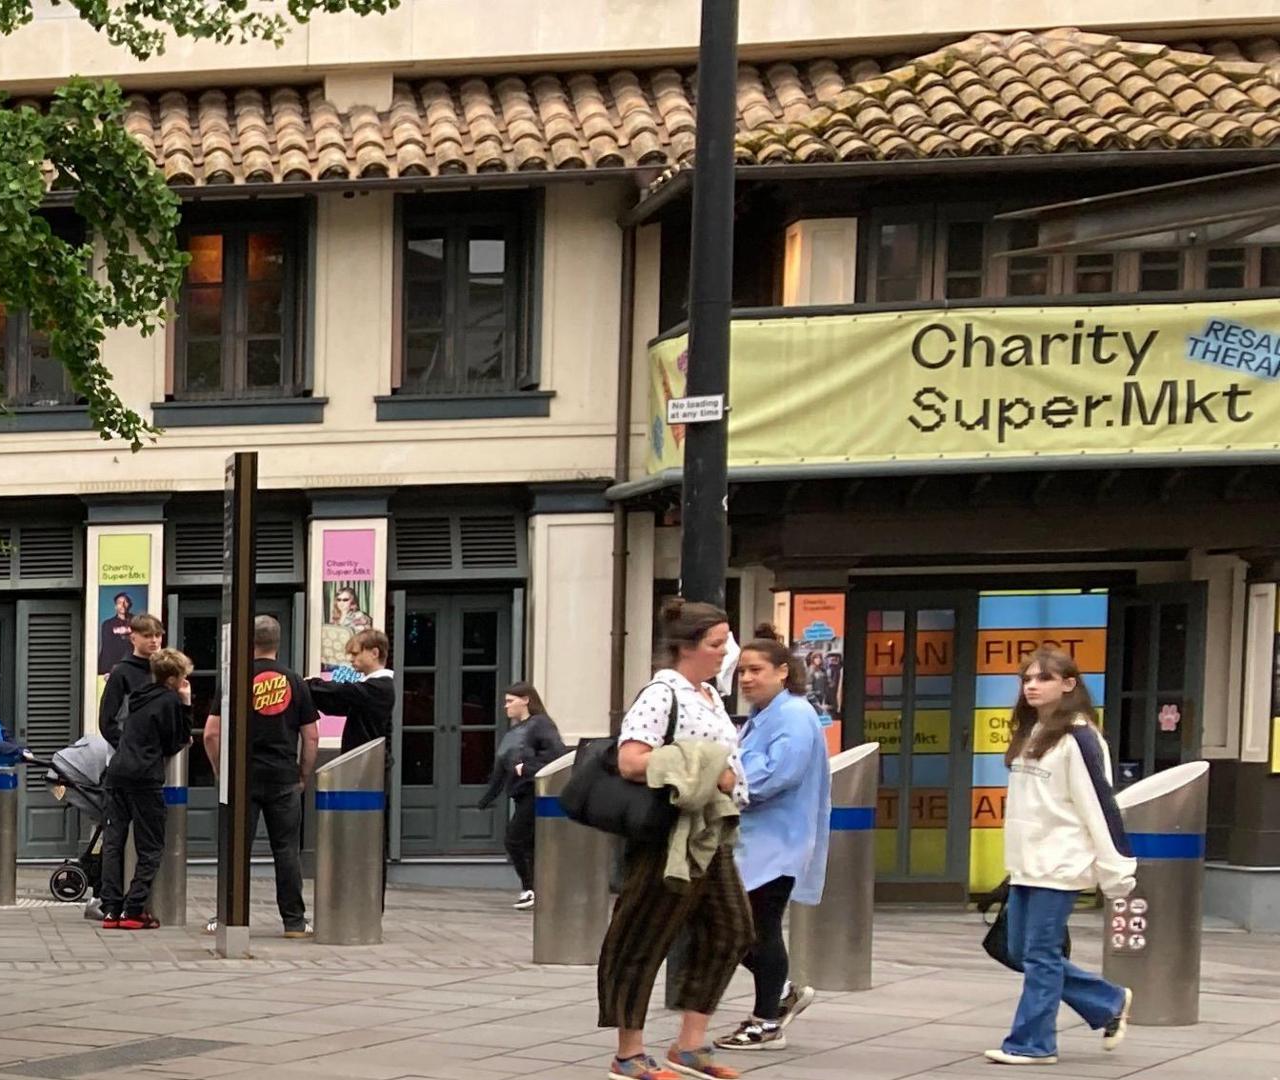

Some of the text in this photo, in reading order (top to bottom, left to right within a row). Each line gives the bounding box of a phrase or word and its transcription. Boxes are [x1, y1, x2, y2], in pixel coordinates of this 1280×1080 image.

[911, 319, 1160, 376] Charity
[1189, 337, 1280, 378] THERA
[671, 399, 719, 409] No loading
[671, 411, 679, 419] at
[700, 409, 719, 417] time
[907, 379, 1254, 443] Super.Mkt
[102, 563, 135, 573] Charity
[326, 560, 359, 569] Charity
[985, 639, 1083, 664] FIRT
[254, 689, 287, 710] CRUZ
